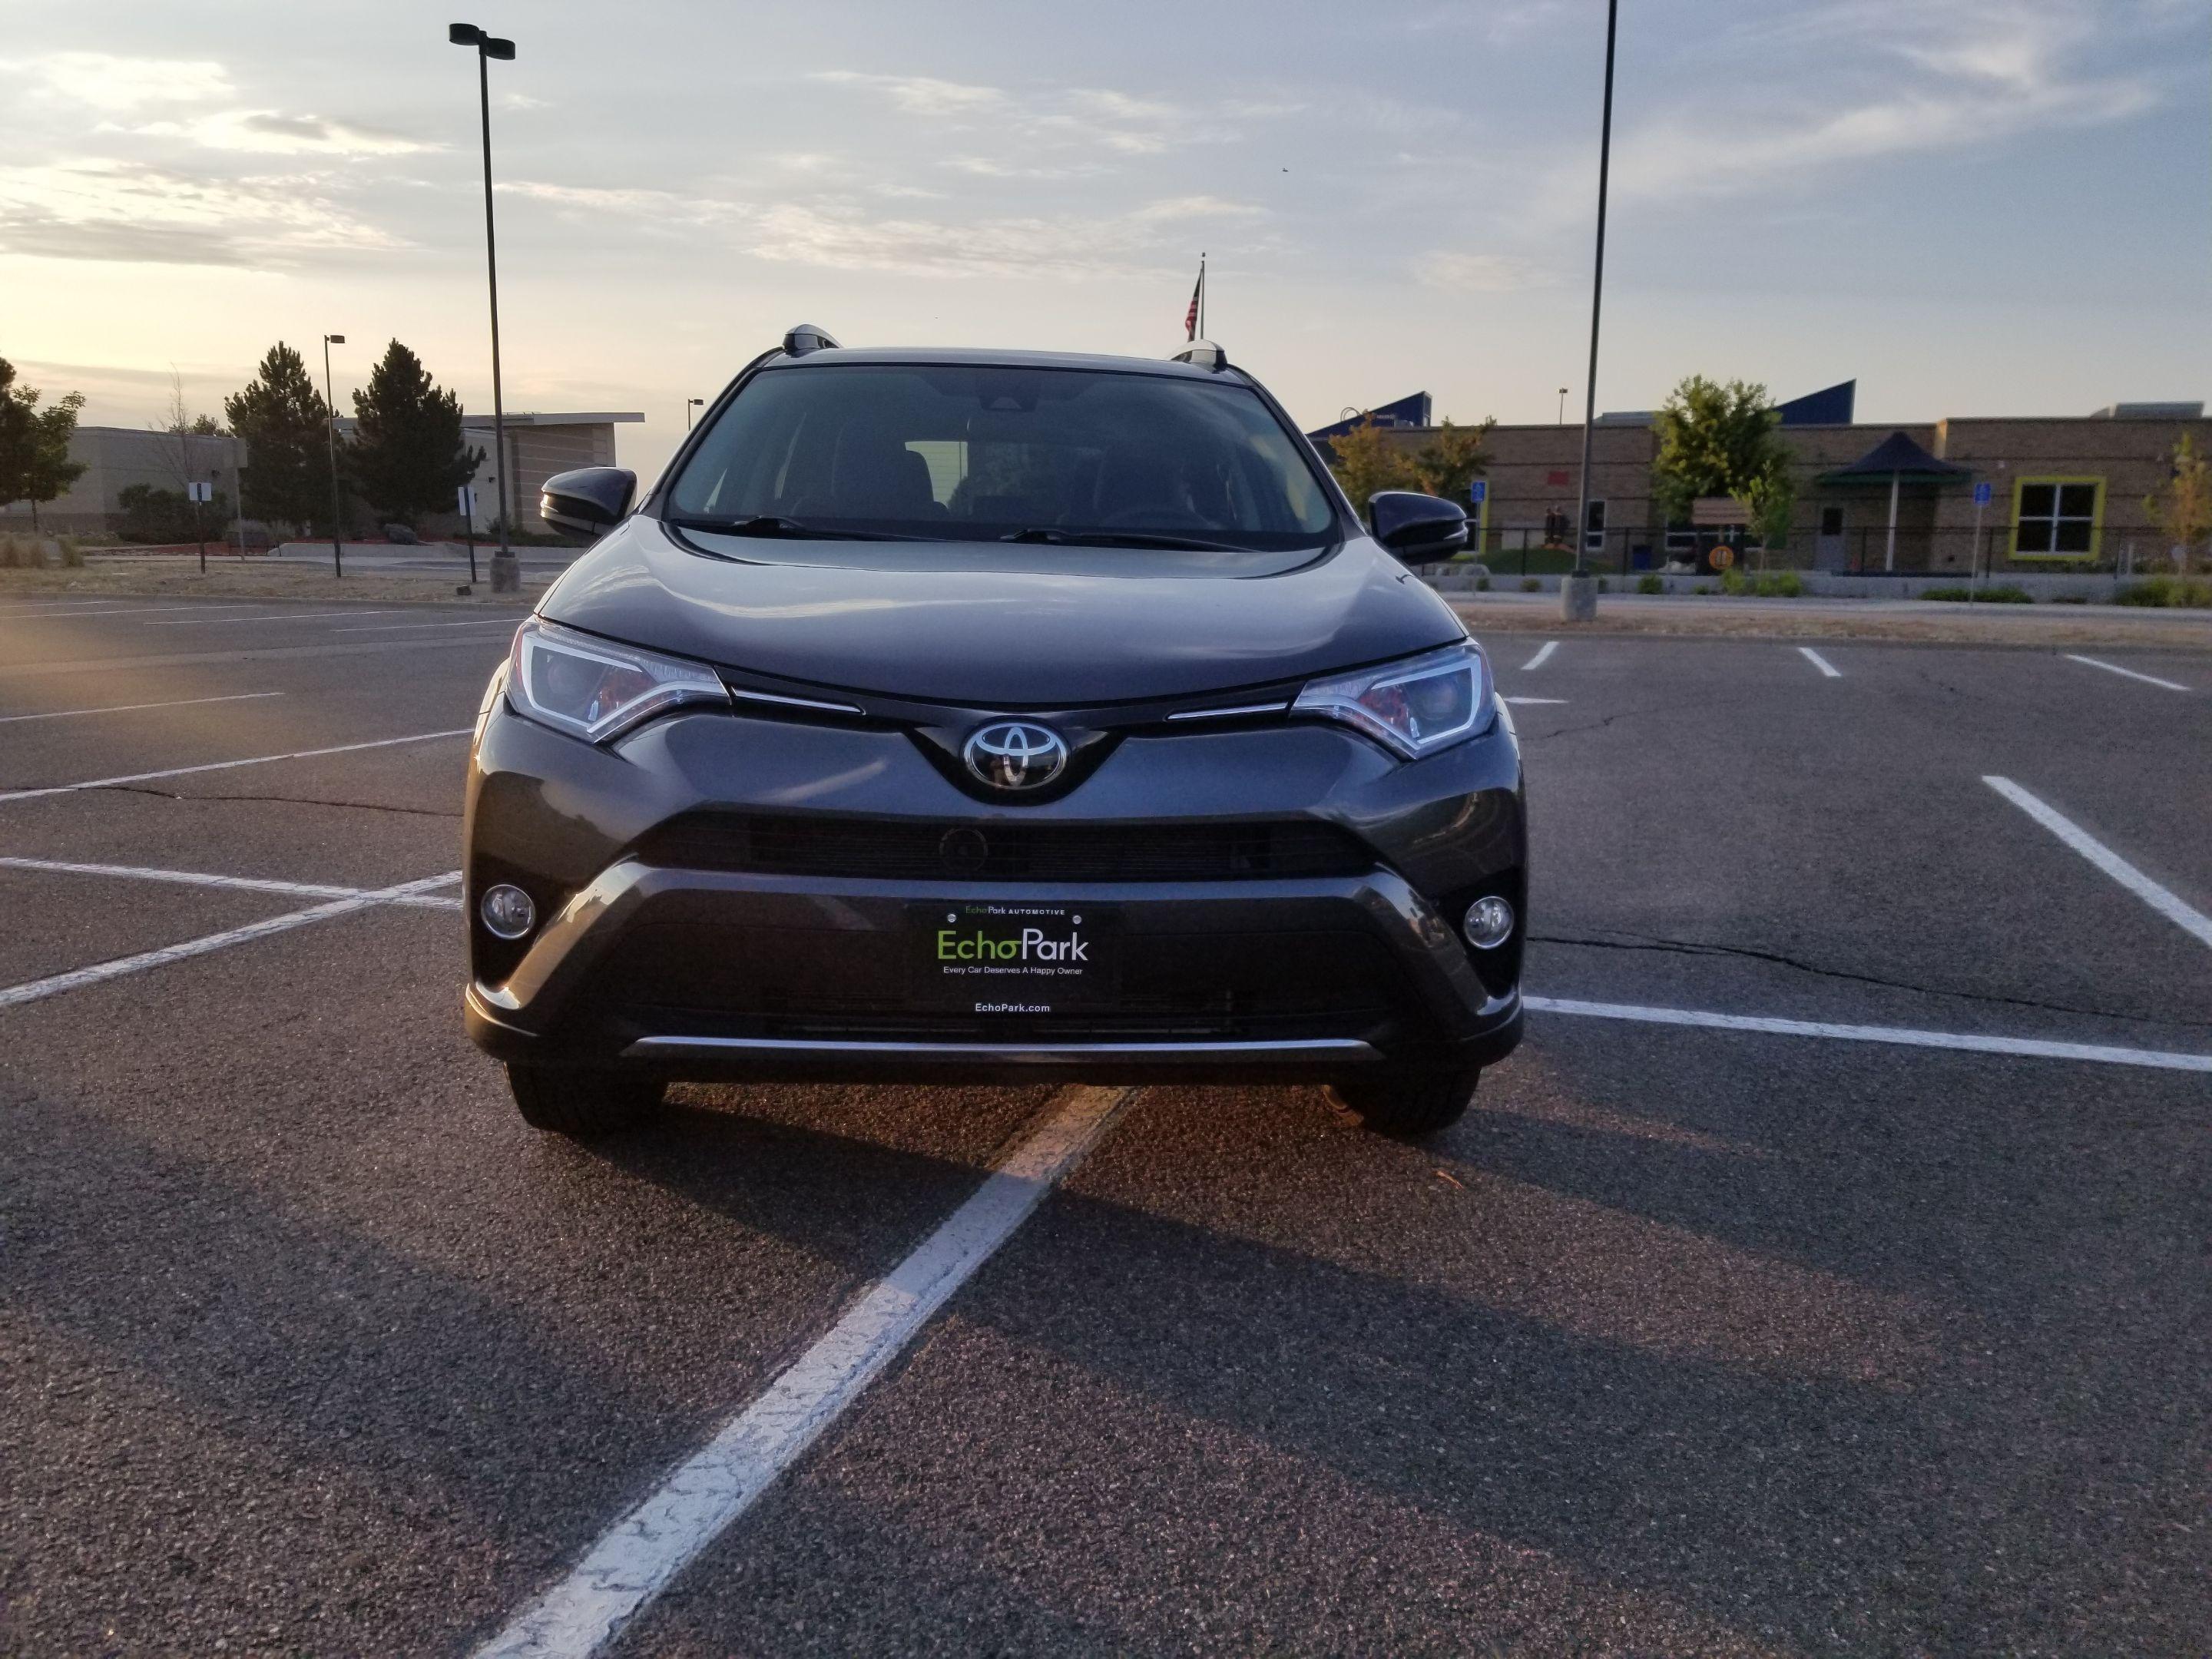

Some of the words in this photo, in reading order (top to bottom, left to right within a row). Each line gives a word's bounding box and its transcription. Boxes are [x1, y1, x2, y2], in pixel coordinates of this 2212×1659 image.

[965, 906, 1006, 914] EchoPark
[938, 928, 1089, 961] EchoPark
[943, 966, 965, 975] Every
[1030, 967, 1055, 975] Happy
[975, 1002, 1051, 1012] EchoPark.com
